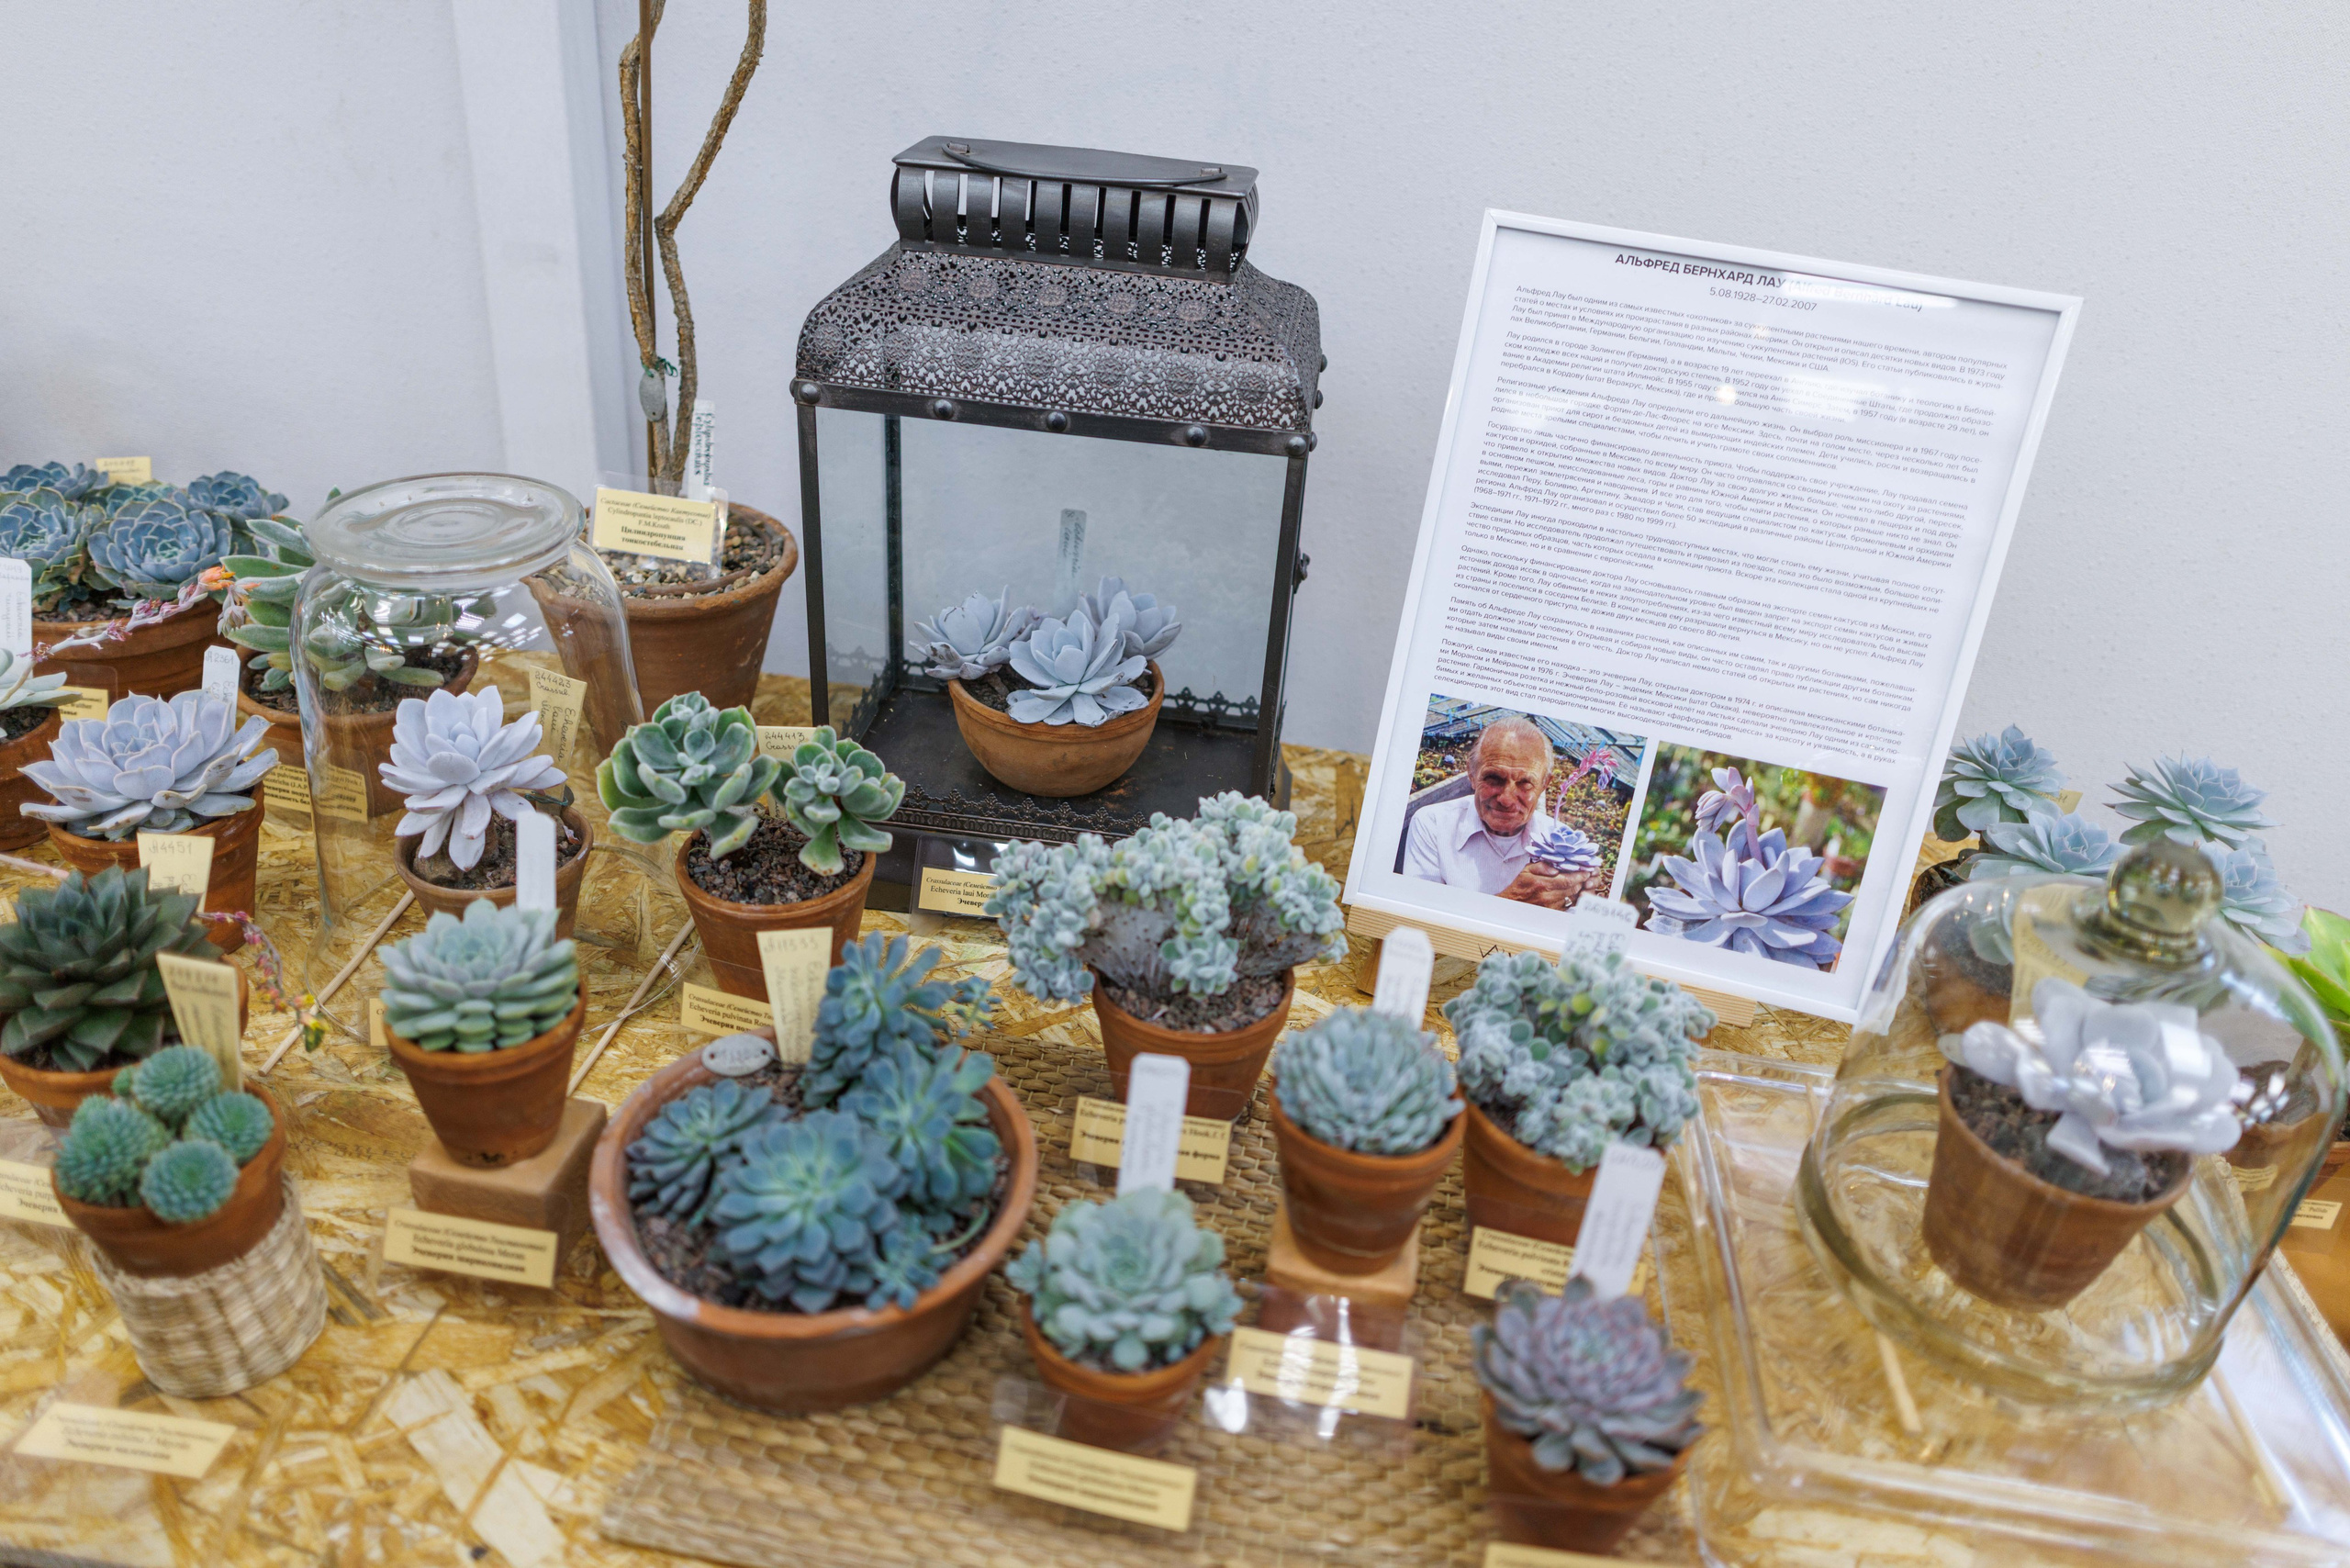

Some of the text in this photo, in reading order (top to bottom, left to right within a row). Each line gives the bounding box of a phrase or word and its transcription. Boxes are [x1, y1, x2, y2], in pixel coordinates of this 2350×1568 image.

[1614, 253, 1681, 274] АЛЬФРЕД
[1682, 263, 1754, 286] БЕРНХАРД
[1755, 274, 1785, 288] ЛАУ
[1513, 296, 1539, 305] статей
[1545, 301, 1572, 310] местах
[1578, 306, 1614, 317] условиях
[1625, 313, 1684, 328] произрастания
[1689, 323, 1719, 334] разных
[1719, 329, 1752, 340] районах
[1752, 332, 1789, 344] Америки.
[1791, 338, 1804, 347] Он
[1803, 342, 1833, 352] открыл
[1840, 348, 1870, 358] описал
[1869, 353, 1903, 364] десятки
[1903, 358, 1930, 367] новых
[1930, 362, 1957, 372] видов.
[1966, 366, 1986, 376] 1973
[1985, 371, 2006, 381] году
[1516, 285, 1551, 297] Альфред
[1550, 290, 1567, 300] Лау
[1566, 293, 1583, 302] был
[1583, 297, 1608, 306] одним
[1618, 302, 1644, 311] самых
[1643, 307, 1685, 318] известных
[1685, 313, 1732, 325] «охотников»
[1743, 321, 1805, 337] суккулентными
[1804, 331, 1852, 344] растениями
[1852, 339, 1884, 350] нашего
[1883, 343, 1921, 357] времени,
[1921, 351, 1957, 362] автором
[1957, 355, 2009, 370] популярных
[1509, 315, 1524, 323] лах
[1524, 316, 1588, 334] Великобритании,
[1588, 326, 1627, 340] Германии,
[1628, 332, 1662, 346] Бельгии,
[1662, 338, 1705, 353] Голландии,
[1706, 345, 1738, 358] Мальты,
[1739, 351, 1764, 363] Чехии,
[1765, 354, 1800, 367] Мексики
[1807, 362, 1830, 373] США.
[1511, 304, 1527, 314] Лау
[1527, 307, 1543, 316] был
[1543, 310, 1571, 319] принят
[1577, 314, 1642, 331] Международную
[1642, 326, 1695, 340] организацию
[1706, 336, 1745, 348] изучению
[1745, 343, 1801, 357] суккулентных
[1800, 352, 1839, 364] растений
[1839, 356, 1860, 368] (IOS).
[1861, 360, 1876, 369] Его
[1876, 364, 1903, 374] статьи
[1904, 368, 1966, 384] публиковались
[1974, 380, 2004, 389] журна-
[600, 497, 711, 519] Cactaceae (Семейство Кактусовые)
[608, 507, 703, 527] Cylindropuntia leptocaulis (DC.)
[1511, 493, 1522, 501] гг.,
[1571, 504, 1595, 514] много
[1594, 509, 1609, 517] раз
[1616, 510, 1635, 521] 1980
[1634, 515, 1645, 523] по
[1646, 516, 1664, 526] 1999
[1664, 521, 1677, 530] гг.).
[621, 526, 686, 542] Цилиндропунция
[621, 537, 684, 551] тонкостебельная
[1454, 625, 1486, 637] называл
[1485, 632, 1505, 641] виды
[1505, 635, 1529, 645] своим
[1529, 641, 1558, 651] именем.
[1433, 674, 1733, 740] селекционеров этот вид стал прародителем многих высокодекоративных гибридов.
[557, 707, 576, 762] Echeveria
[926, 877, 997, 891] Crassulaceae (Семейство
[930, 885, 961, 895] Echeveria
[957, 897, 984, 908] Эчевер
[688, 993, 725, 1008] Crassulaceae
[726, 1003, 762, 1017] (Семейство
[688, 1002, 721, 1016] Echeveria
[722, 1012, 753, 1025] pulvinata
[699, 1014, 734, 1029] Эчеверия
[0, 1182, 33, 1196] cheveria
